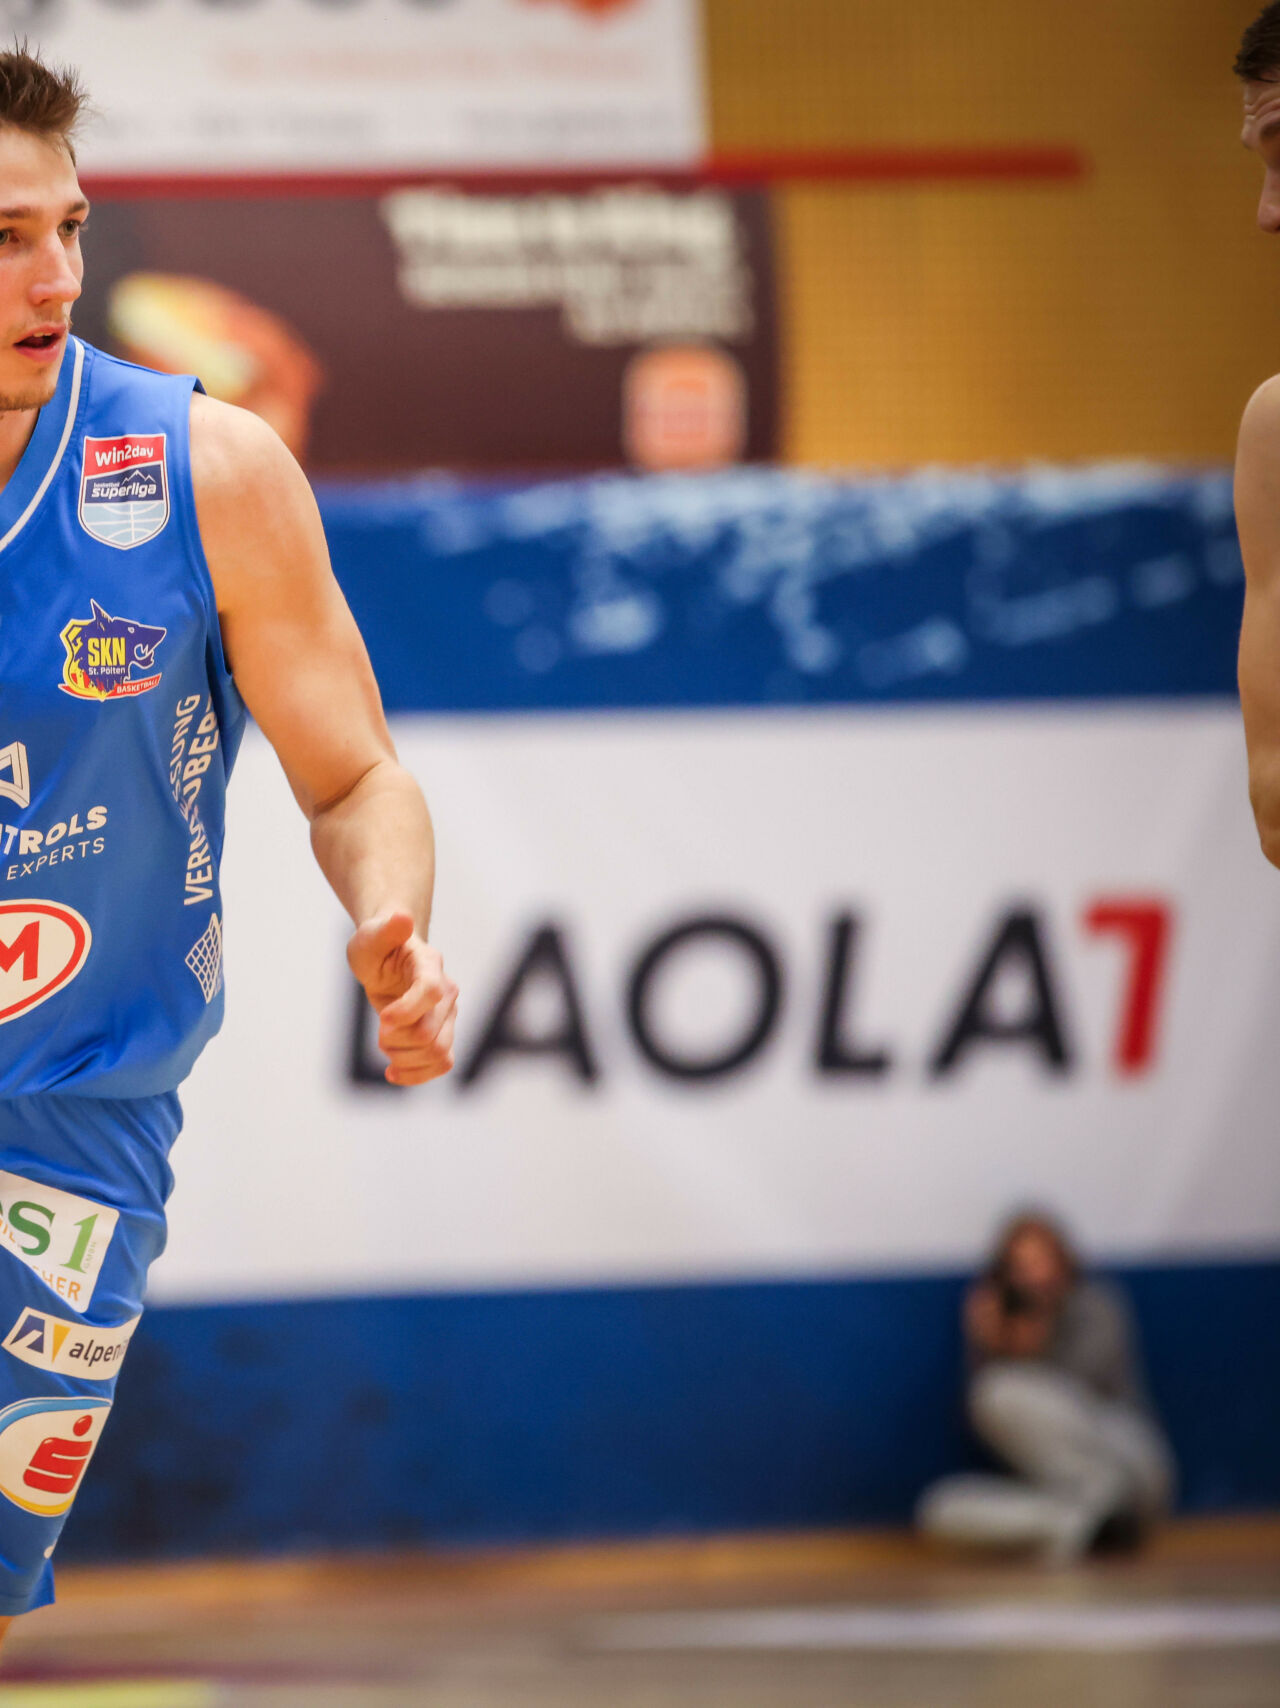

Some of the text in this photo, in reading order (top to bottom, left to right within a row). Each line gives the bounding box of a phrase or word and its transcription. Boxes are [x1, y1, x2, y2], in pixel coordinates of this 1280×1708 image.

[91, 482, 157, 499] superliga
[87, 637, 126, 667] SKN
[88, 666, 126, 676] St. Pölten
[116, 679, 158, 694] BASKETBALL
[6, 837, 106, 881] EXPERTS
